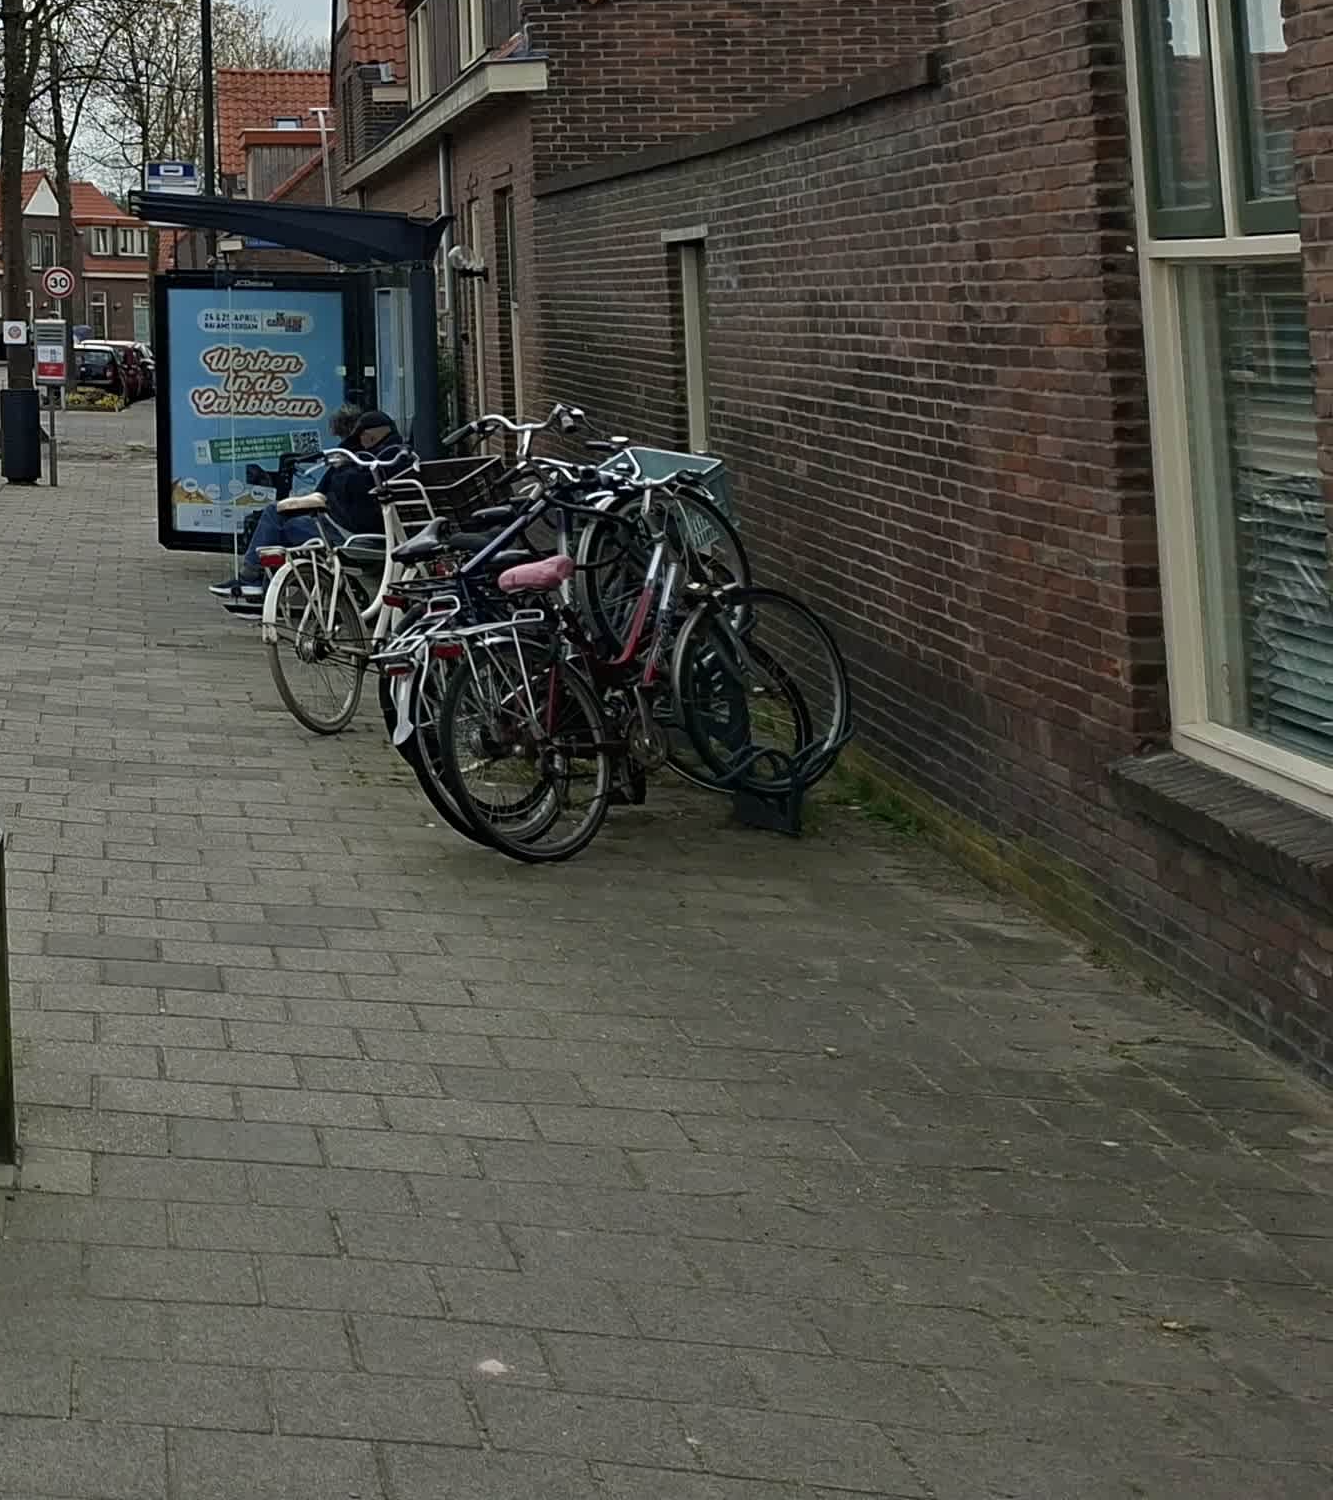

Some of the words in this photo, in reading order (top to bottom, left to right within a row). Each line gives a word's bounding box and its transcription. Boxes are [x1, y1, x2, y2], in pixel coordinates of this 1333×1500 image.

[49, 277, 68, 289] 30
[234, 313, 257, 322] APRIL
[203, 348, 303, 373] Werken
[254, 372, 288, 393] de
[192, 389, 322, 416] Caribbean
